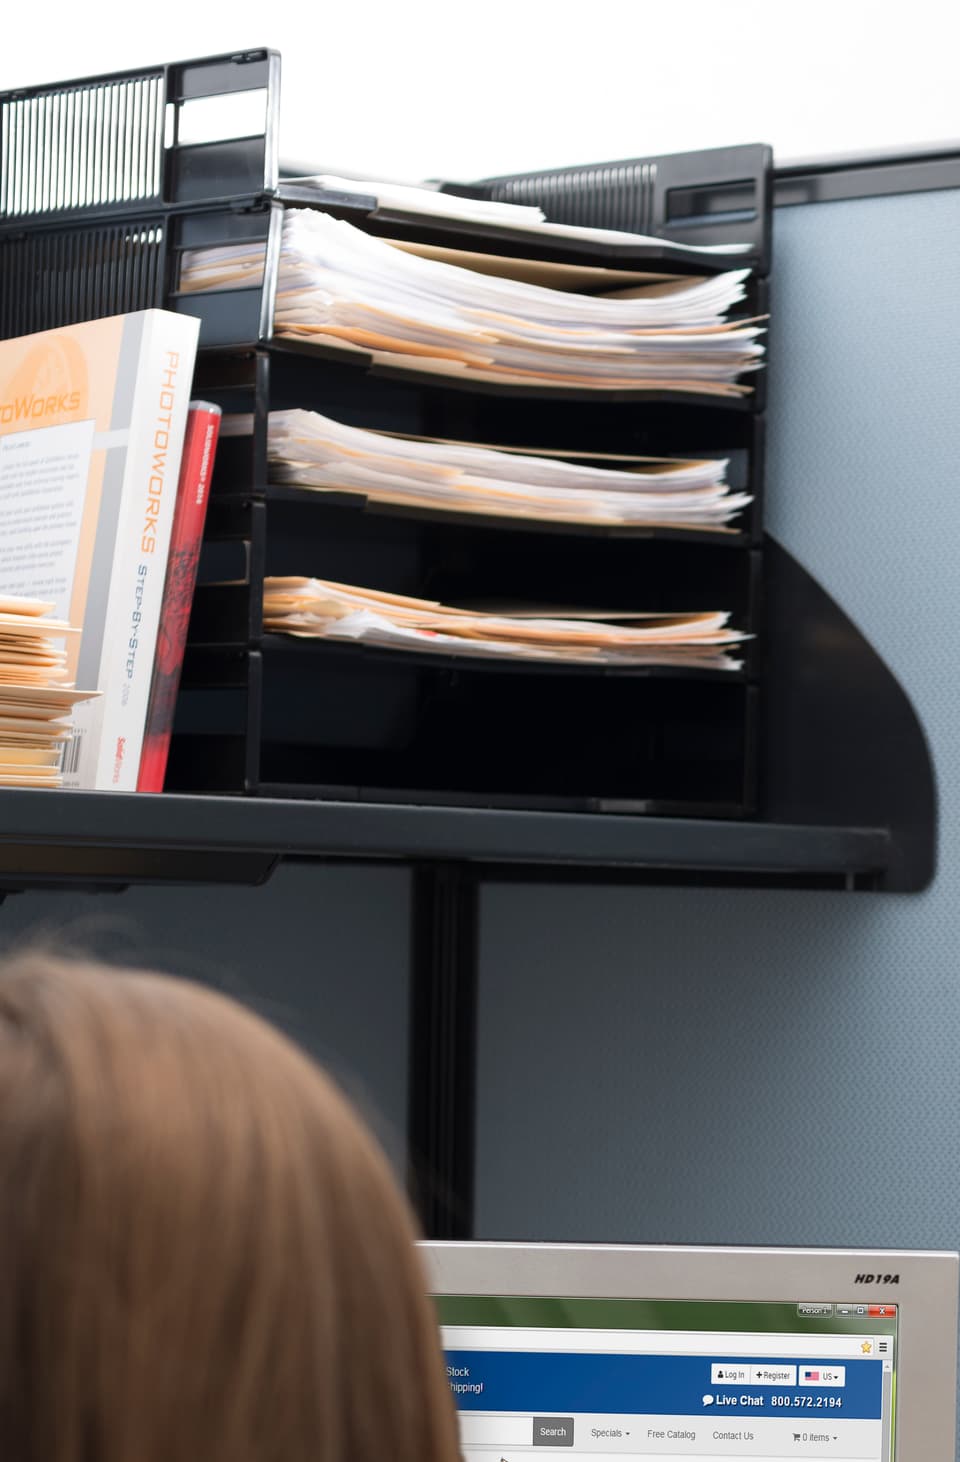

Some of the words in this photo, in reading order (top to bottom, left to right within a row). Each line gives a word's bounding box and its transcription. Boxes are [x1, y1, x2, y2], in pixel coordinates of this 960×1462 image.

[140, 350, 179, 554] PHOTOWORKS
[854, 1274, 900, 1284] HD19A
[446, 1367, 470, 1377] Stock
[725, 1371, 737, 1380] Log
[738, 1371, 745, 1379] In
[763, 1371, 790, 1381] Register
[823, 1373, 833, 1381] US
[716, 1395, 737, 1406] Live
[741, 1395, 764, 1407] Chat
[771, 1396, 843, 1408] 800.572.2194
[540, 1427, 566, 1437] Search
[591, 1428, 622, 1439] Specials
[647, 1430, 665, 1439] Free
[667, 1430, 696, 1441] Catalog
[712, 1431, 742, 1440] Contact
[744, 1431, 754, 1441] Us
[802, 1433, 808, 1441] 0
[809, 1433, 830, 1442] items
